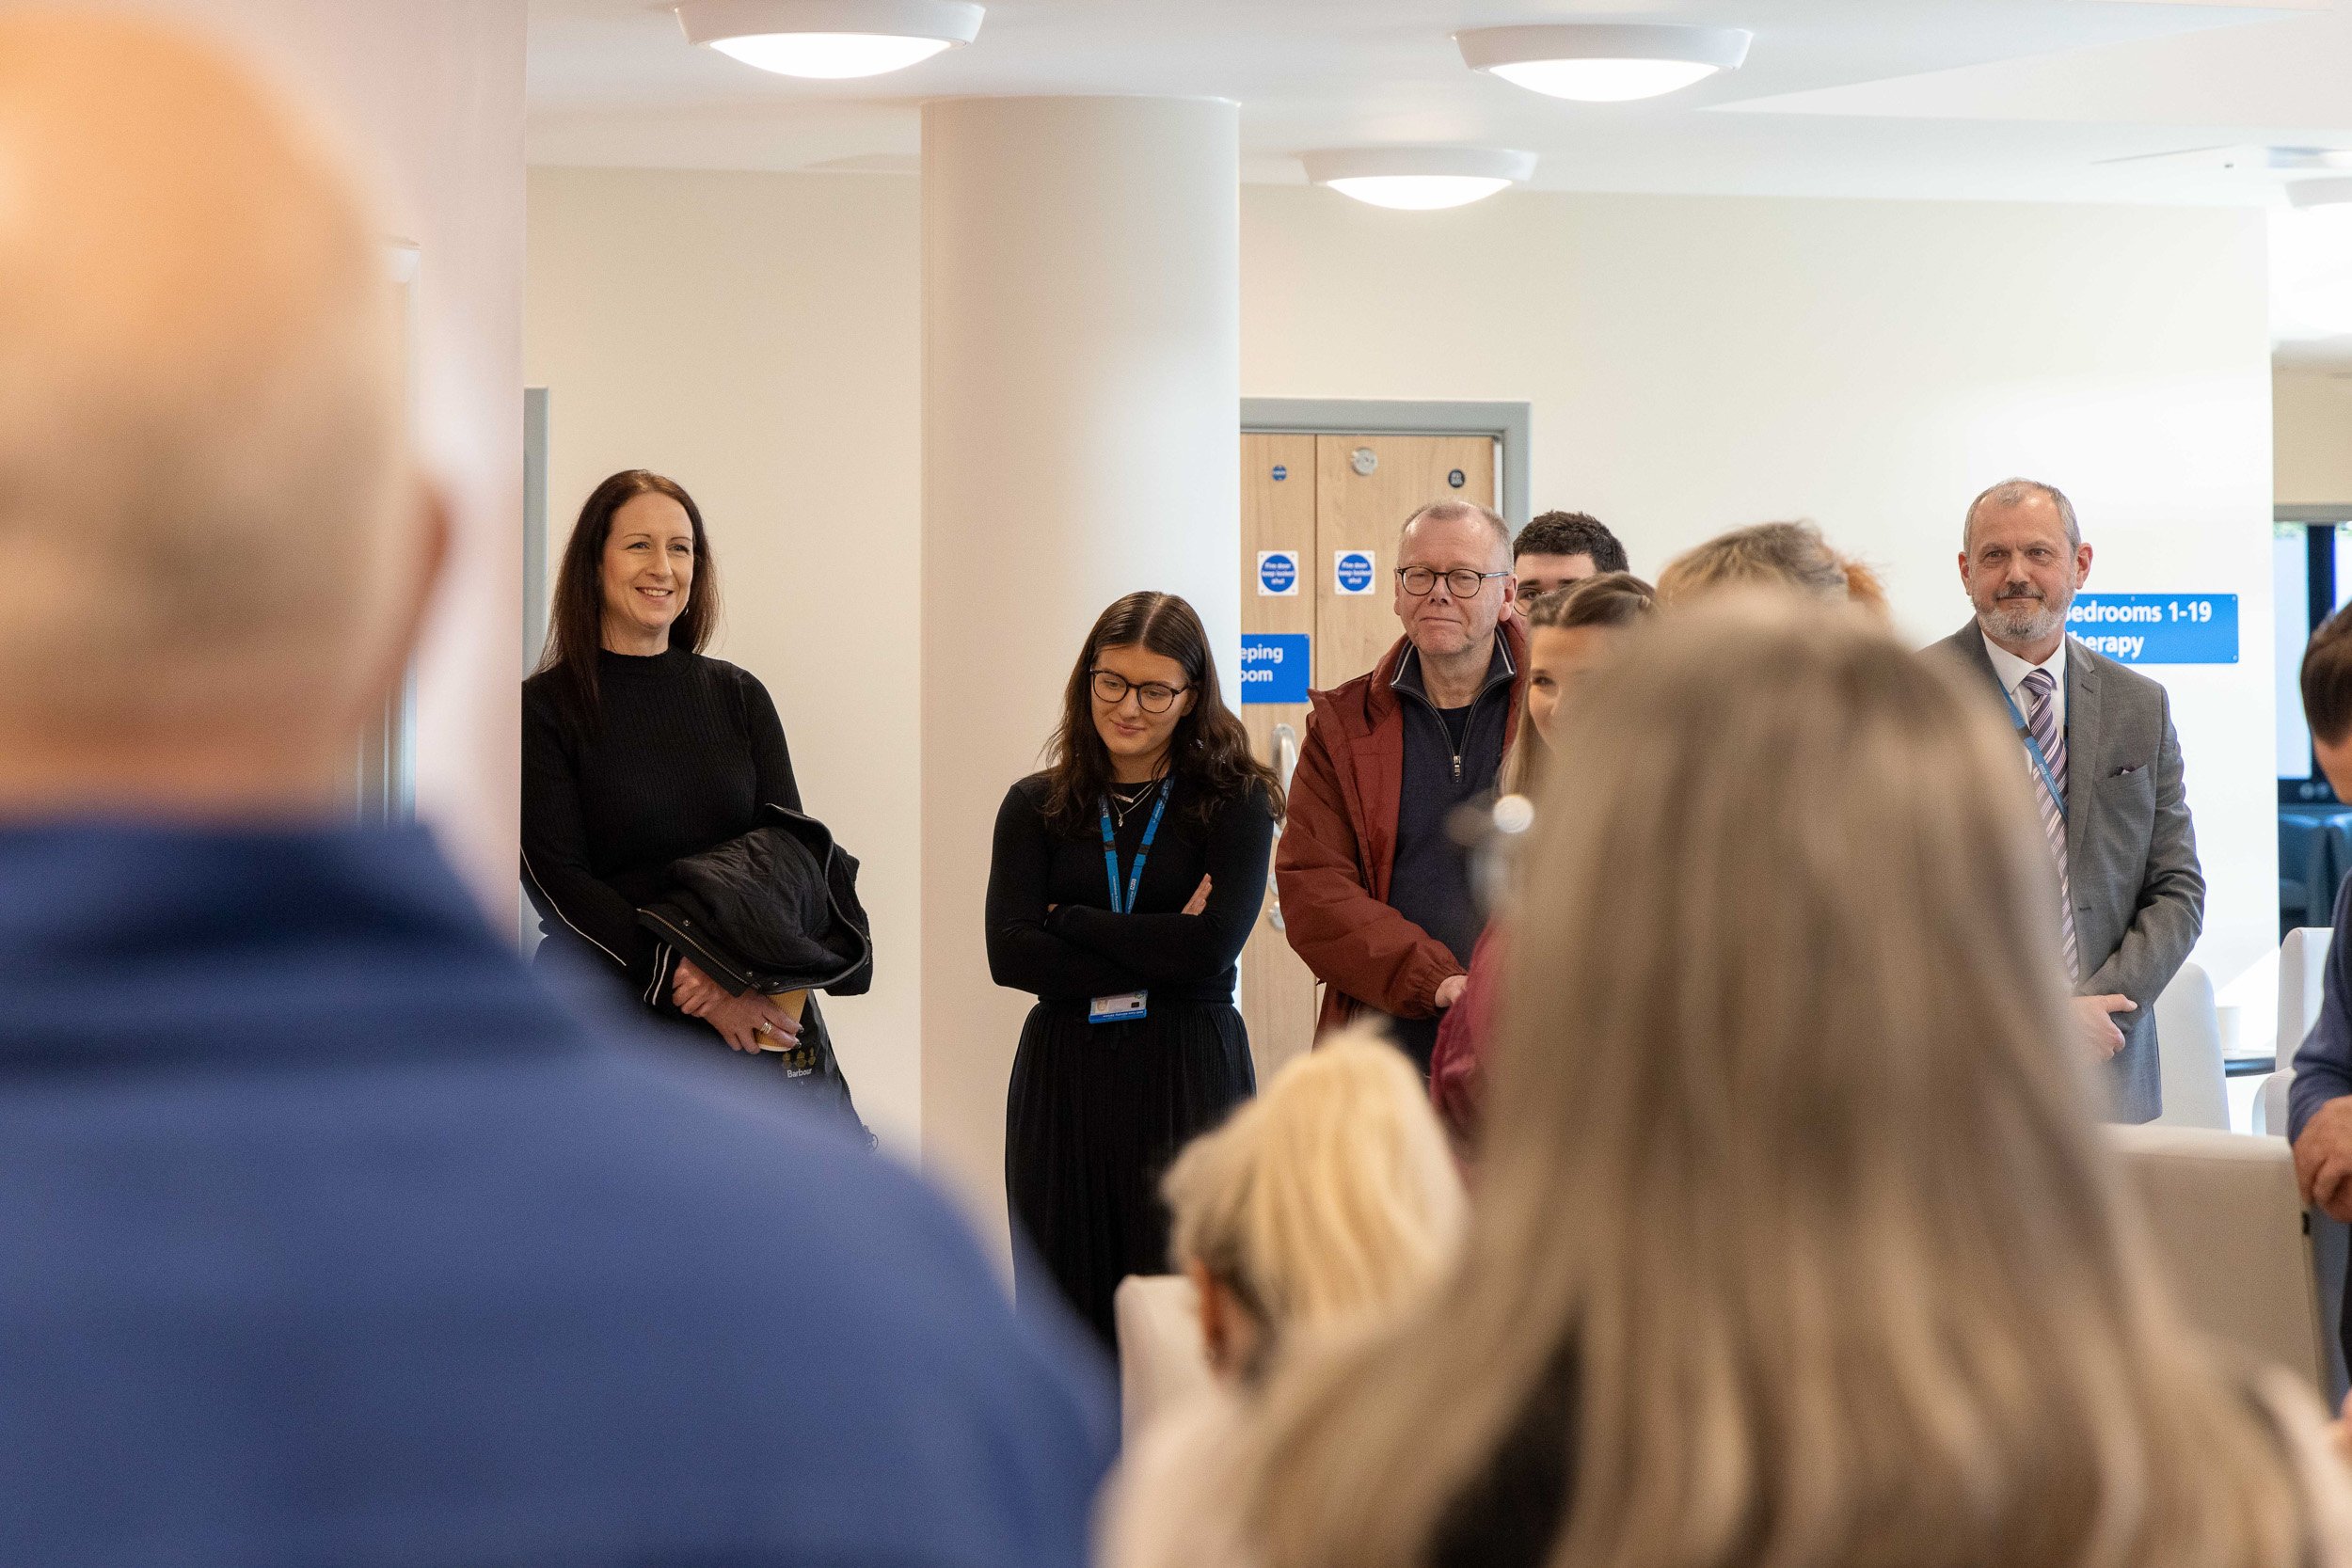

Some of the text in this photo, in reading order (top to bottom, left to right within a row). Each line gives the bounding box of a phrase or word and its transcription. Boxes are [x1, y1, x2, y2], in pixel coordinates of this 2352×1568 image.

[2066, 600, 2213, 623] edrooms 1-19
[2069, 630, 2145, 659] herapy
[787, 1068, 813, 1078] Barbour
